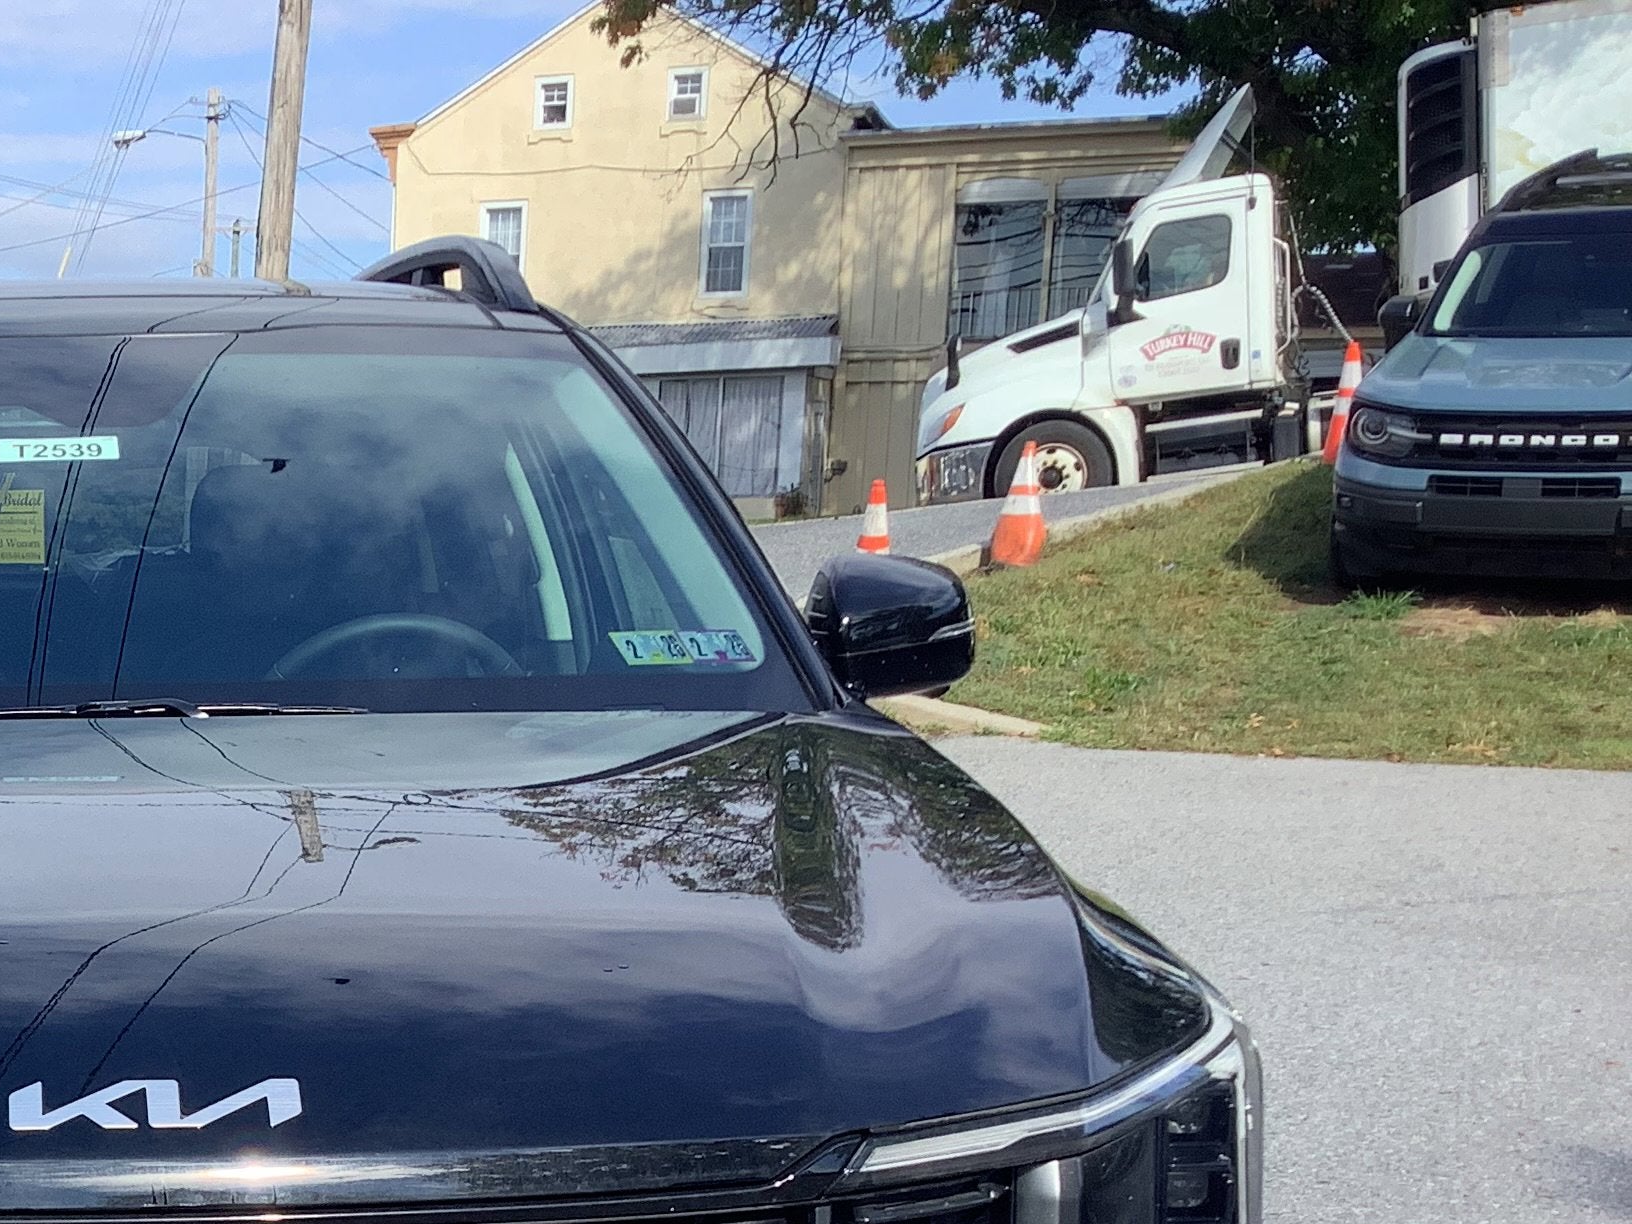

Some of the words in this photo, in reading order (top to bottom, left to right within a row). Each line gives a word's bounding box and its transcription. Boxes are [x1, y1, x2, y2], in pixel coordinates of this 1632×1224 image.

[1143, 334, 1187, 356] TURKEY
[1188, 332, 1211, 349] HILL
[1439, 433, 1620, 446] BRONCO
[12, 442, 103, 458] T2539
[8, 1078, 303, 1131] KIA
